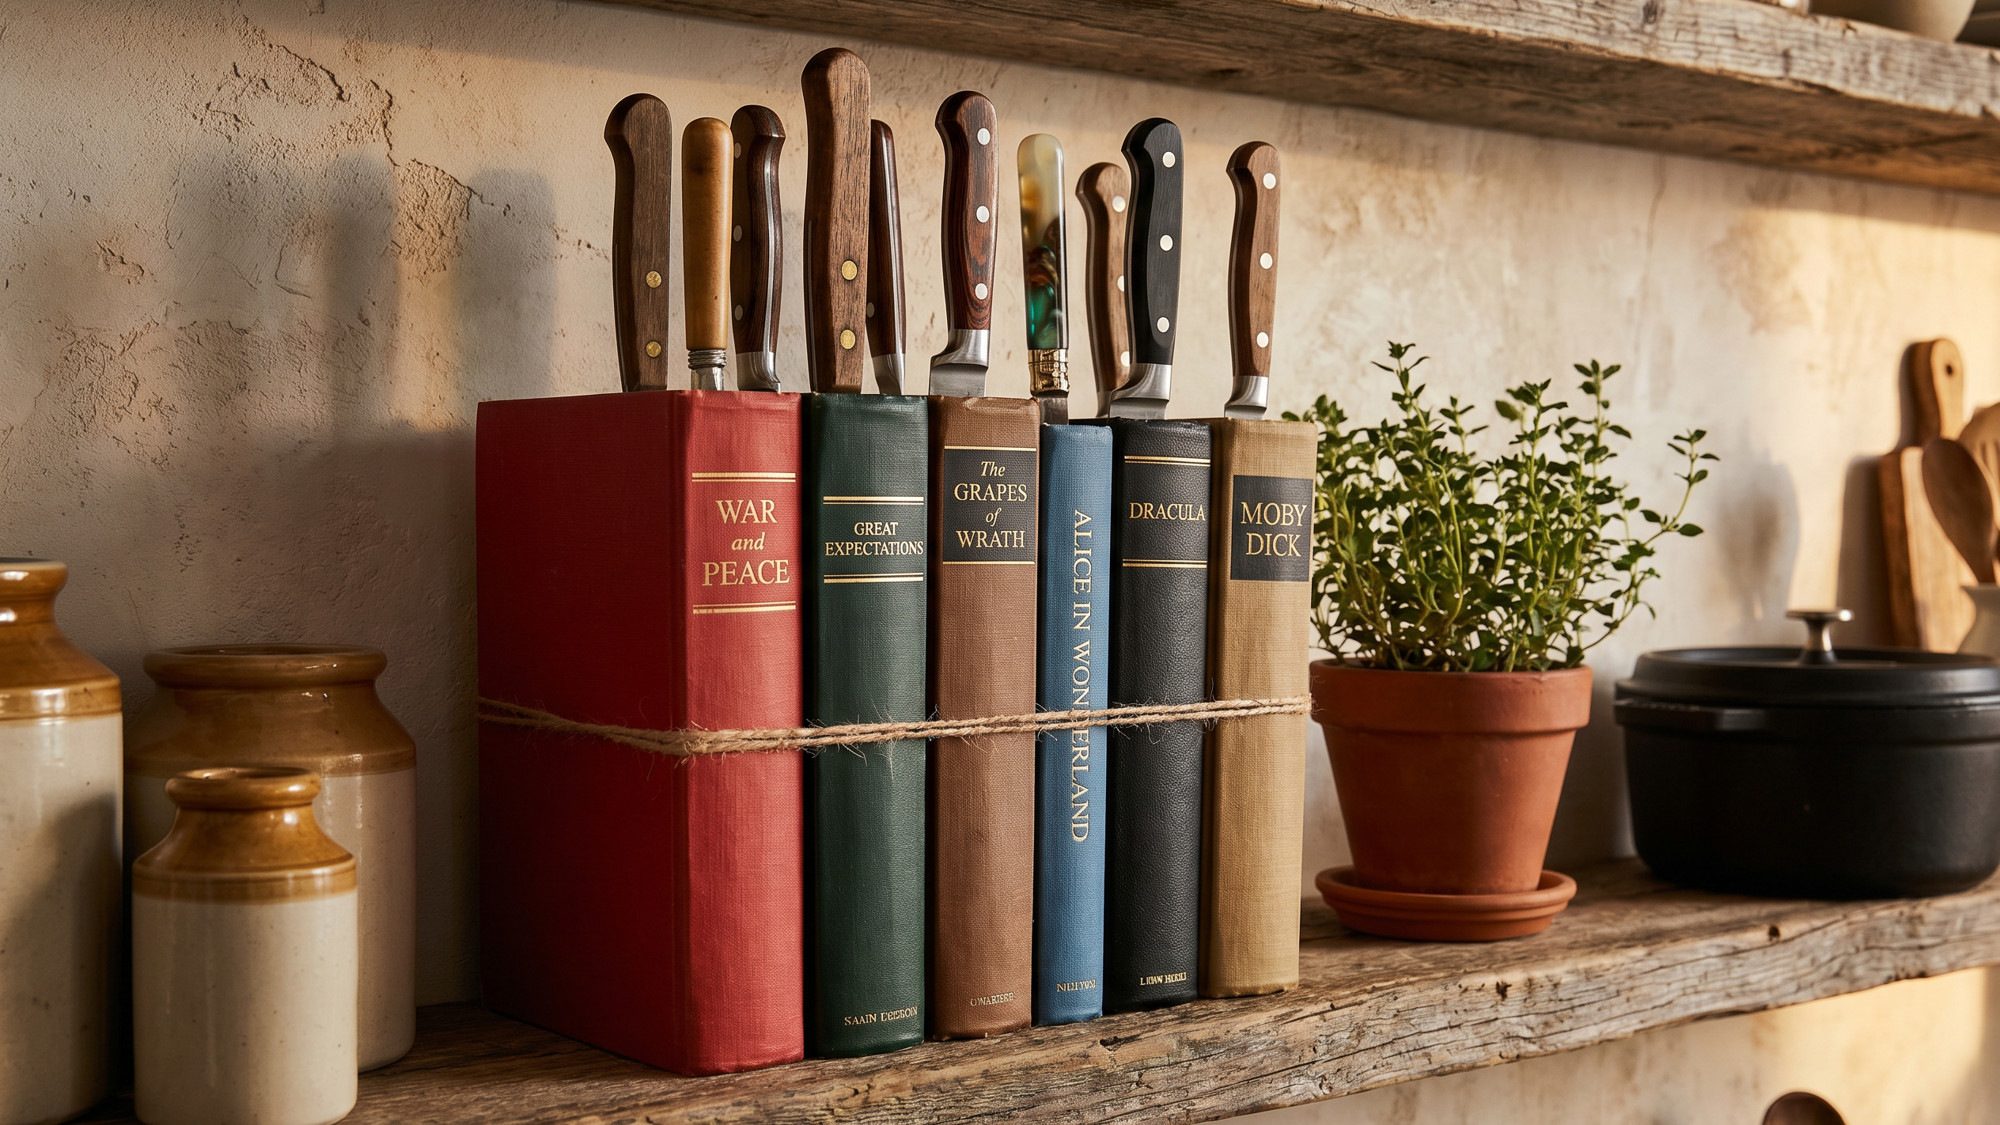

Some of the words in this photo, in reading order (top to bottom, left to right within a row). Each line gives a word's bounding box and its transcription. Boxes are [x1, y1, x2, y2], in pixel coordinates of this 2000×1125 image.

[980, 461, 1006, 477] The
[954, 483, 1028, 502] GRAPES
[715, 499, 777, 524] WAR
[985, 507, 1002, 527] of
[1129, 502, 1206, 521] DRACULA
[1241, 501, 1308, 526] MOBY
[854, 521, 899, 536] GREAT
[731, 531, 766, 551] and
[824, 541, 924, 556] EXPECTATIONS
[955, 530, 1025, 548] WRATH
[1245, 532, 1302, 557] DICK
[1073, 509, 1092, 594] ALICE
[702, 559, 791, 586] PEACE
[1073, 601, 1091, 631] IN
[1071, 639, 1091, 842] WONERLAND
